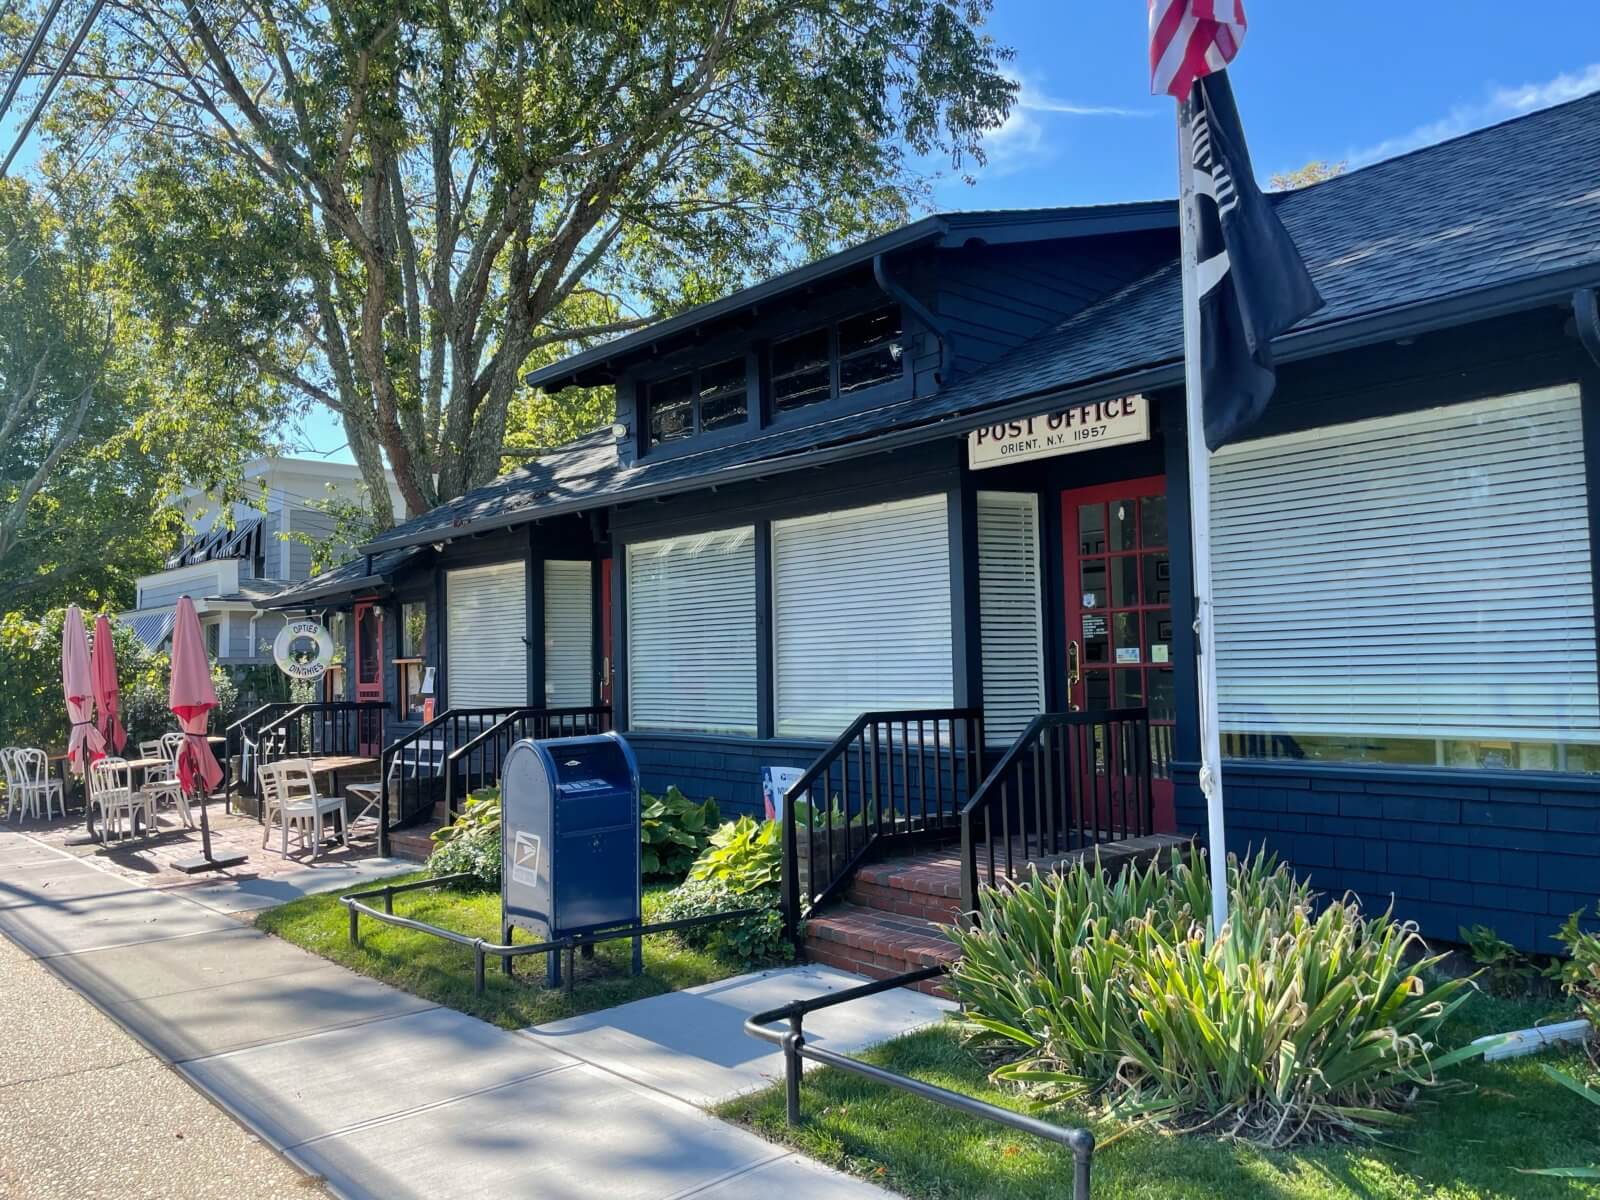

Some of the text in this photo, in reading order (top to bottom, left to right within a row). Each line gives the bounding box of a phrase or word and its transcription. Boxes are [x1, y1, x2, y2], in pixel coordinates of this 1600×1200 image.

[976, 396, 1136, 446] POST OFFICE
[1047, 434, 1065, 446] N.Y.
[1074, 425, 1107, 441] 11957
[293, 624, 318, 634] OPTIES
